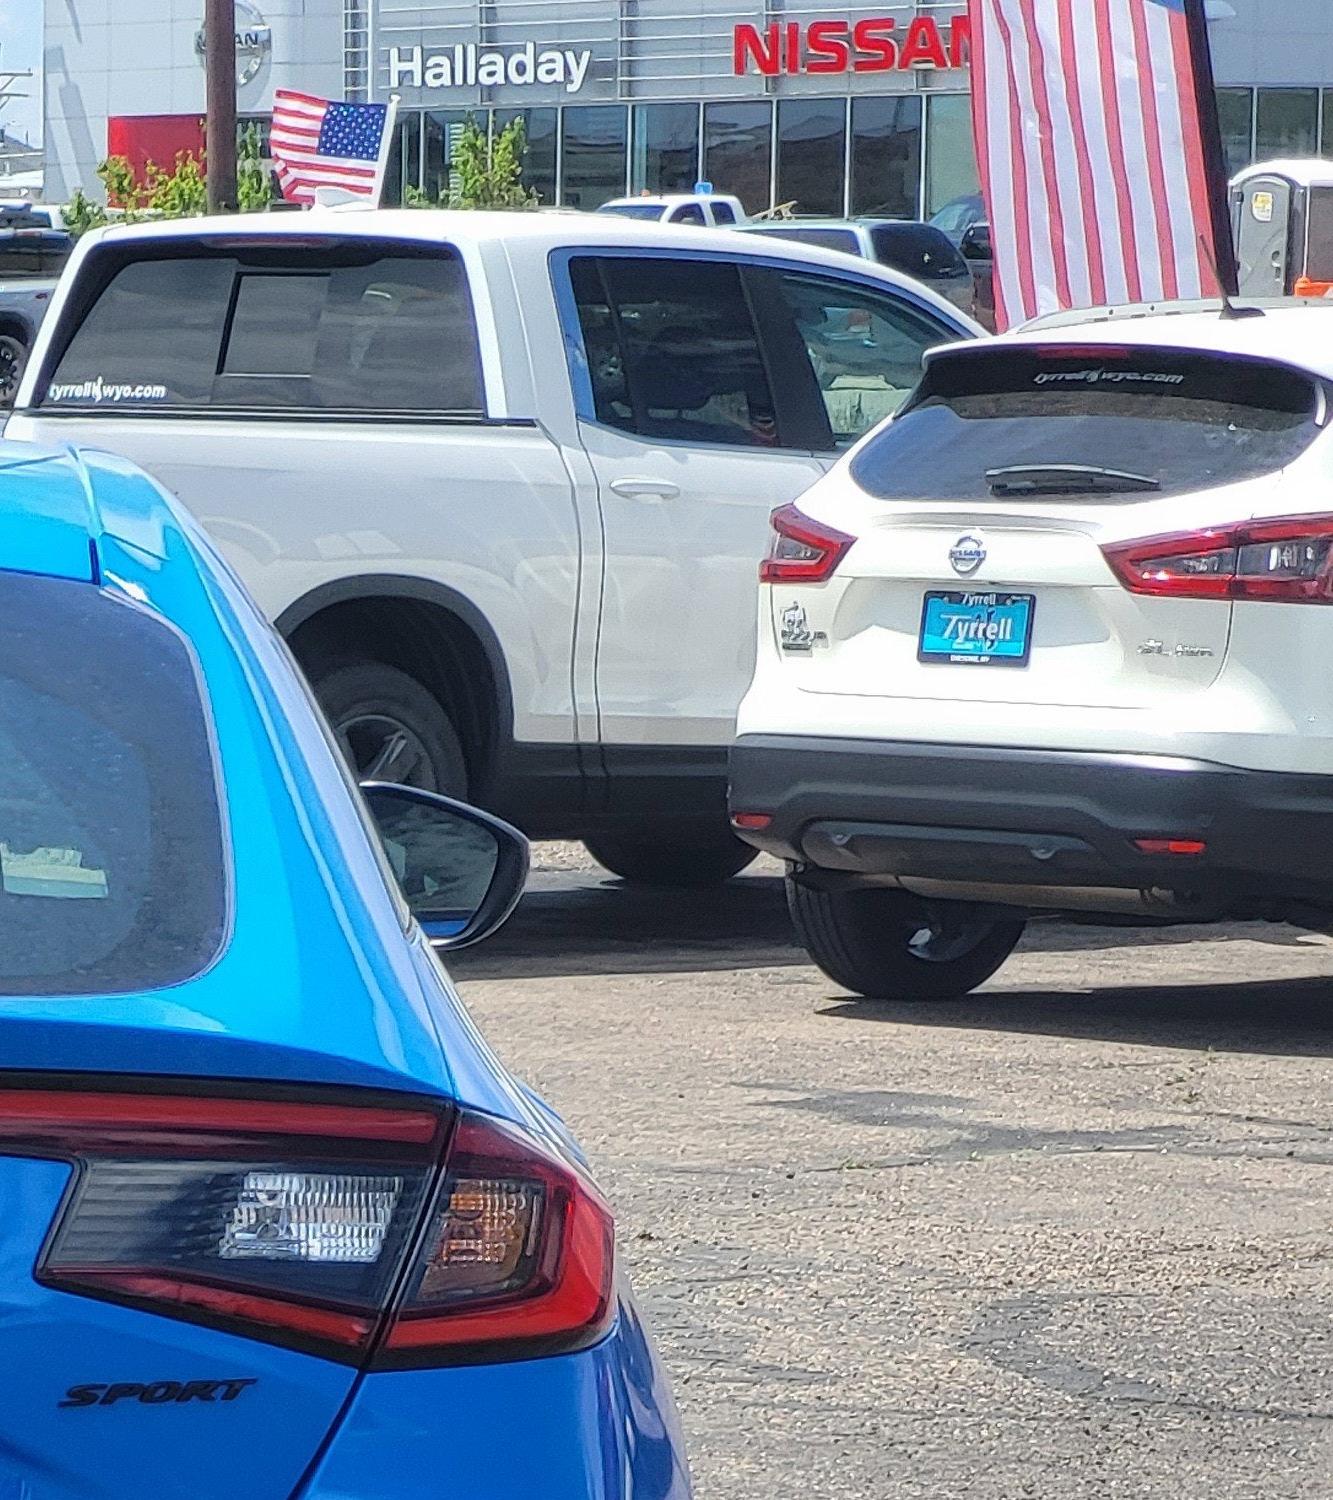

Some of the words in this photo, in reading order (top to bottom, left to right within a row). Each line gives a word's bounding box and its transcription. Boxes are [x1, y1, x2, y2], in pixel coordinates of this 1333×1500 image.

[389, 41, 591, 93] Halladay
[960, 592, 996, 607] Tyrrell
[939, 614, 1013, 644] Tyrrell
[57, 1378, 259, 1408] SPORT
